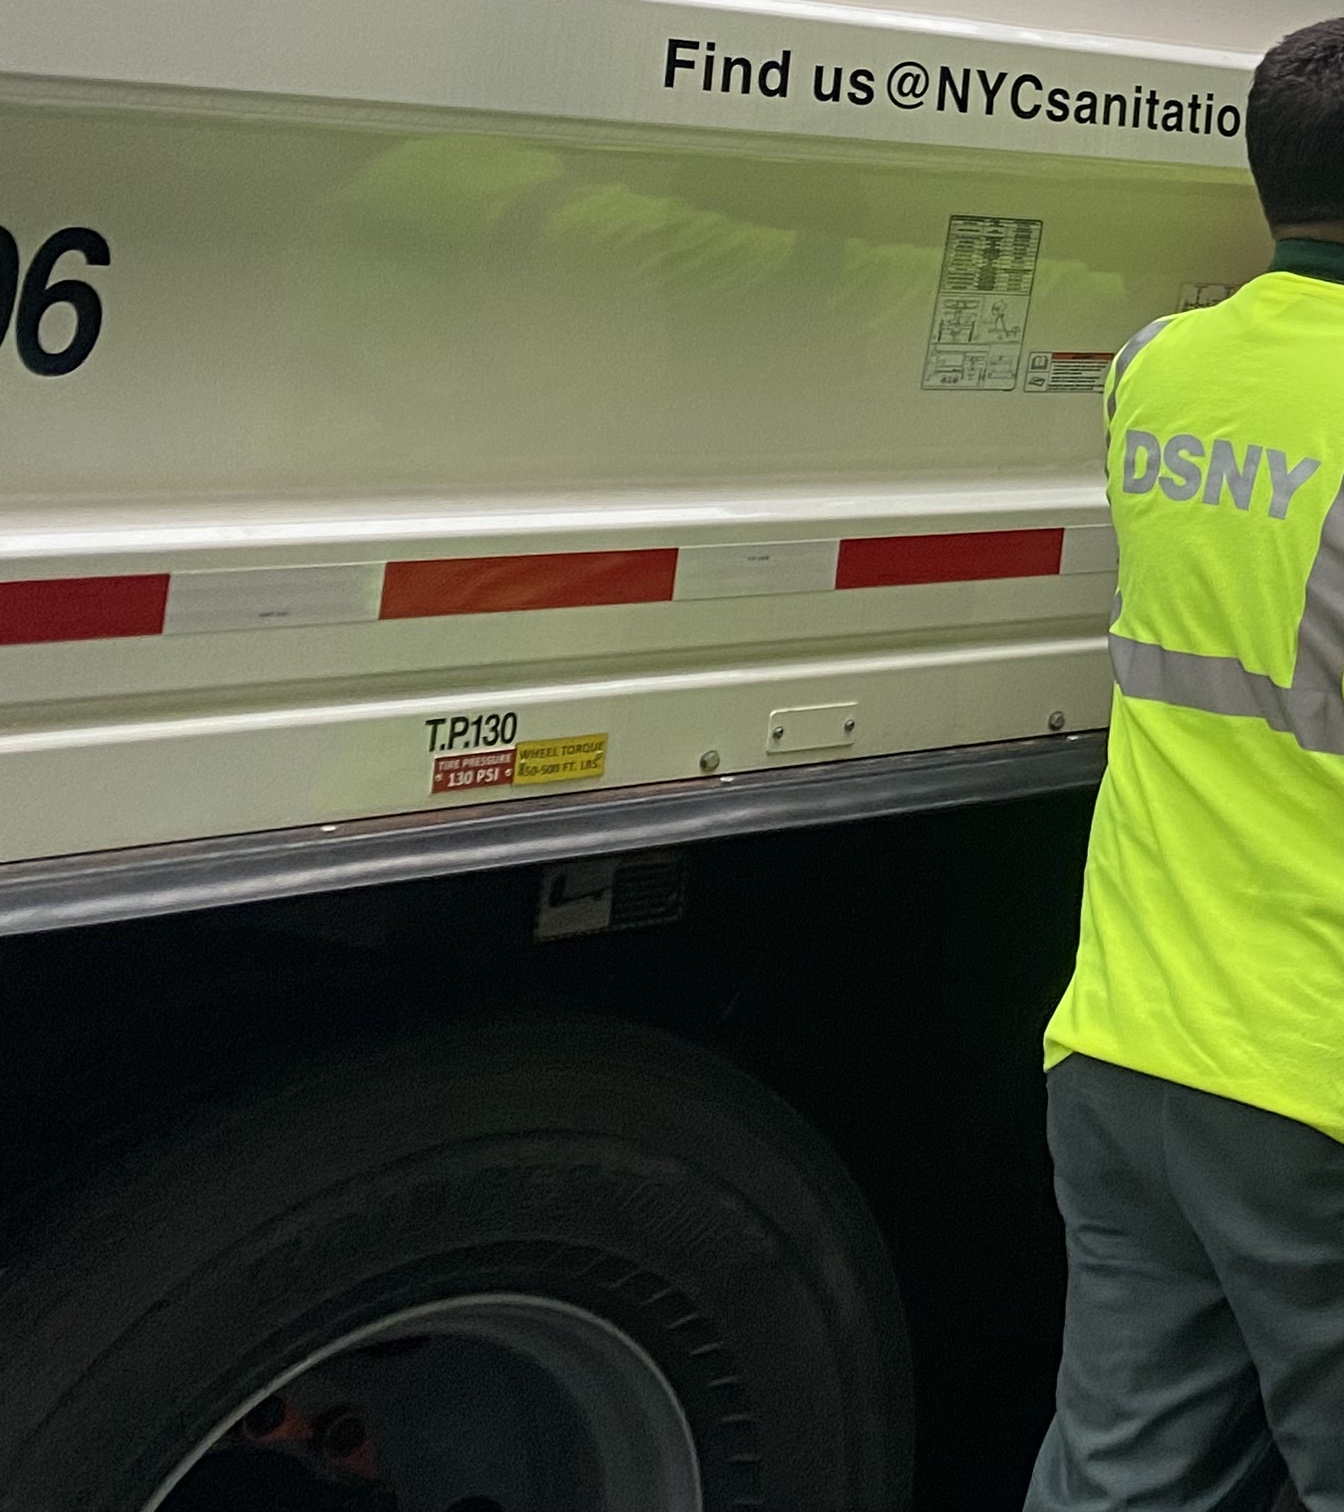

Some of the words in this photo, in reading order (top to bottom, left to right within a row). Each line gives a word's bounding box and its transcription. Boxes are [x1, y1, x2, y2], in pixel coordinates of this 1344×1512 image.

[663, 38, 792, 98] Find
[812, 65, 876, 106] us
[886, 61, 1242, 138] @NYCsanitatio
[0, 225, 110, 378] 6
[1122, 429, 1322, 520] DSNY
[425, 712, 518, 753] T.P.130
[519, 748, 559, 761] WHEEL
[561, 741, 604, 756] TORQUE
[438, 760, 461, 770] TIRE
[462, 752, 512, 768] PRESSURE
[447, 771, 473, 788] 130
[476, 768, 499, 784] PSI
